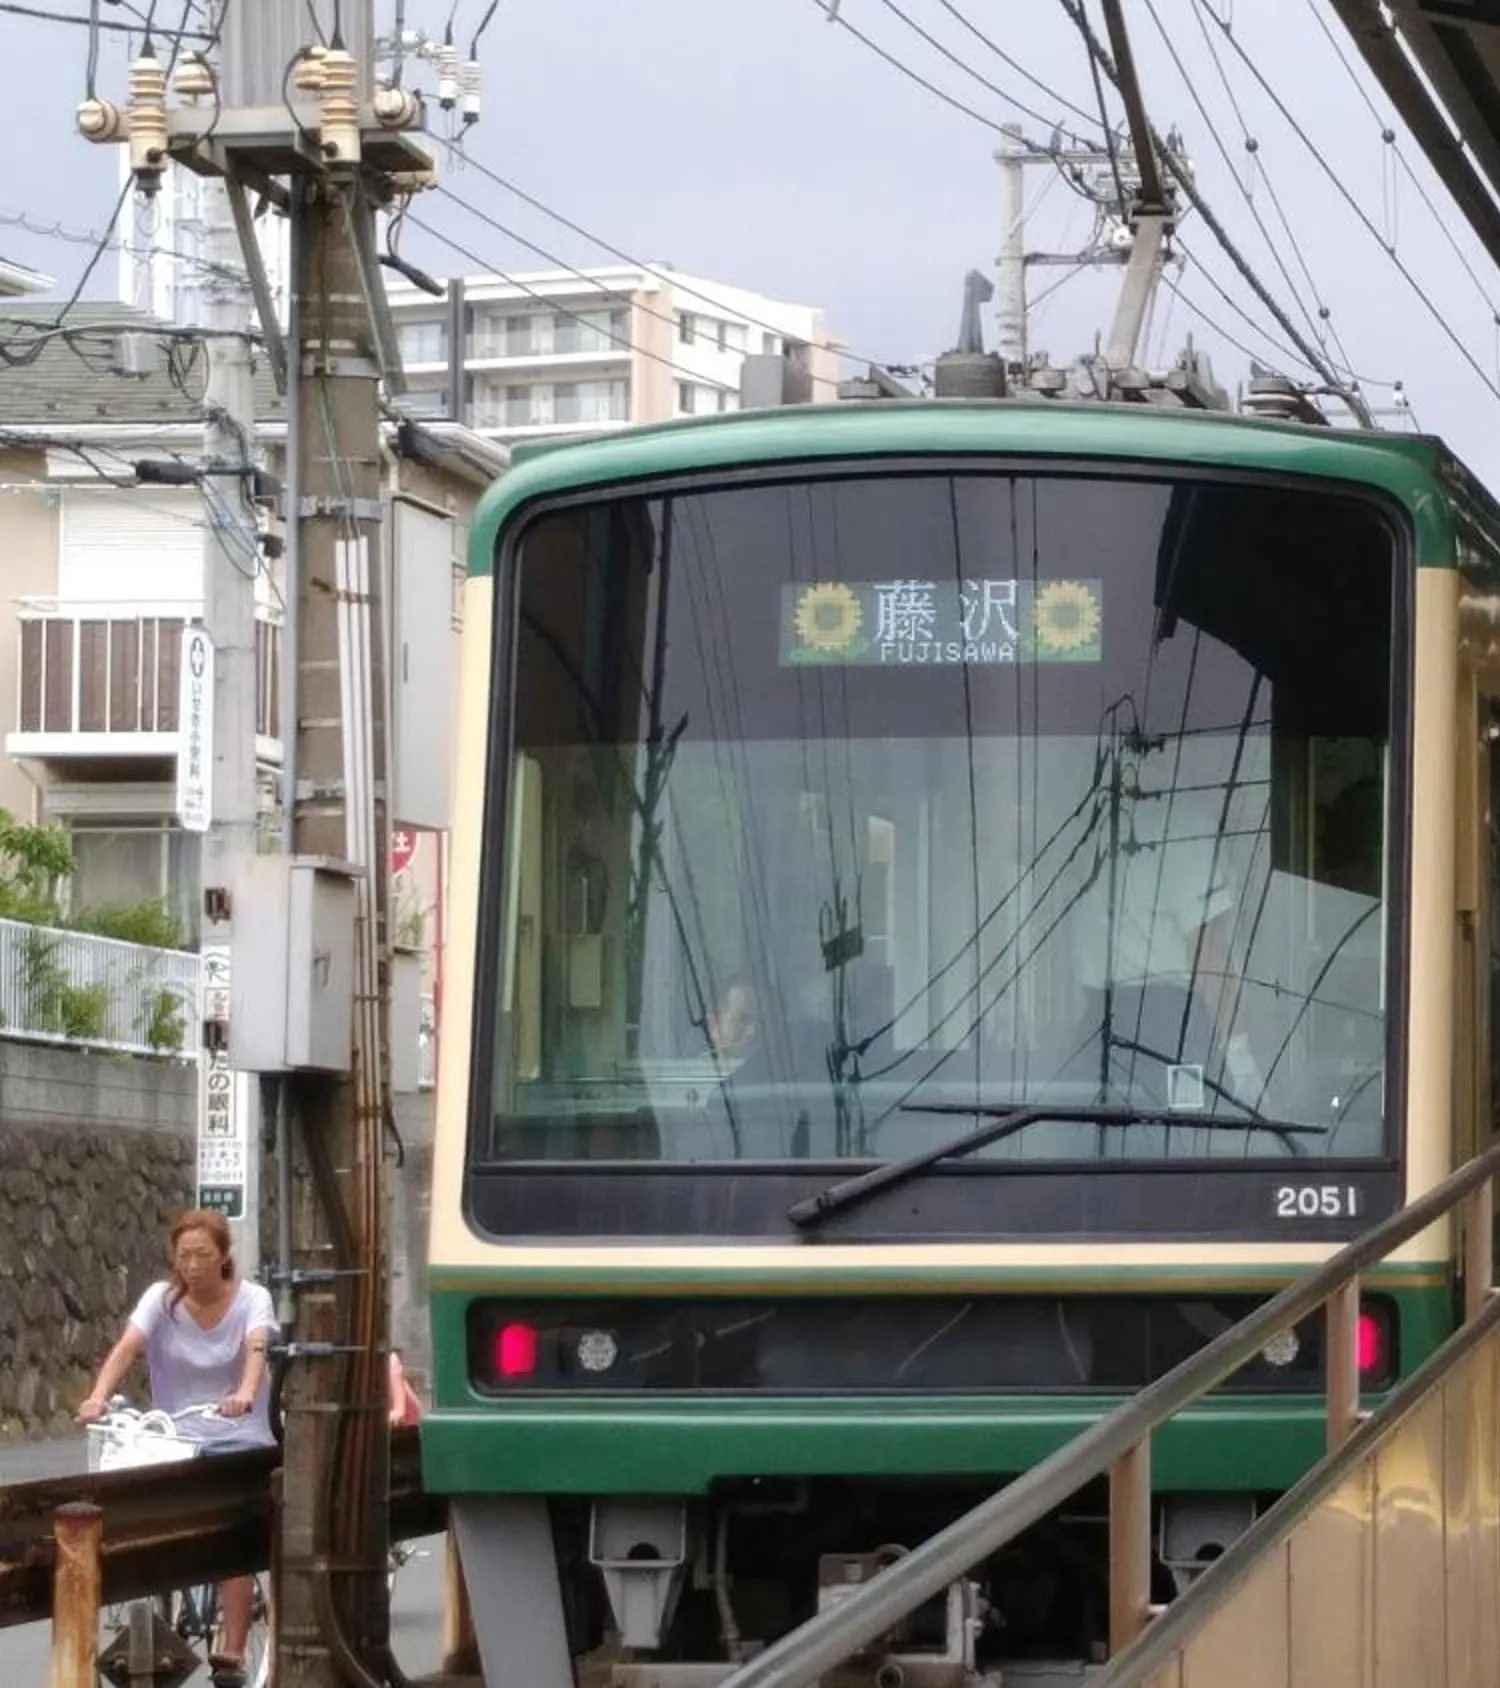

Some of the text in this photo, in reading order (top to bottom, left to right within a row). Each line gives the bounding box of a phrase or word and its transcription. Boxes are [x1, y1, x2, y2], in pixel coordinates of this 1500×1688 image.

[872, 579, 1021, 642] 藤沢
[880, 642, 1014, 664] FUJISAWA
[1276, 1185, 1358, 1218] 2051
